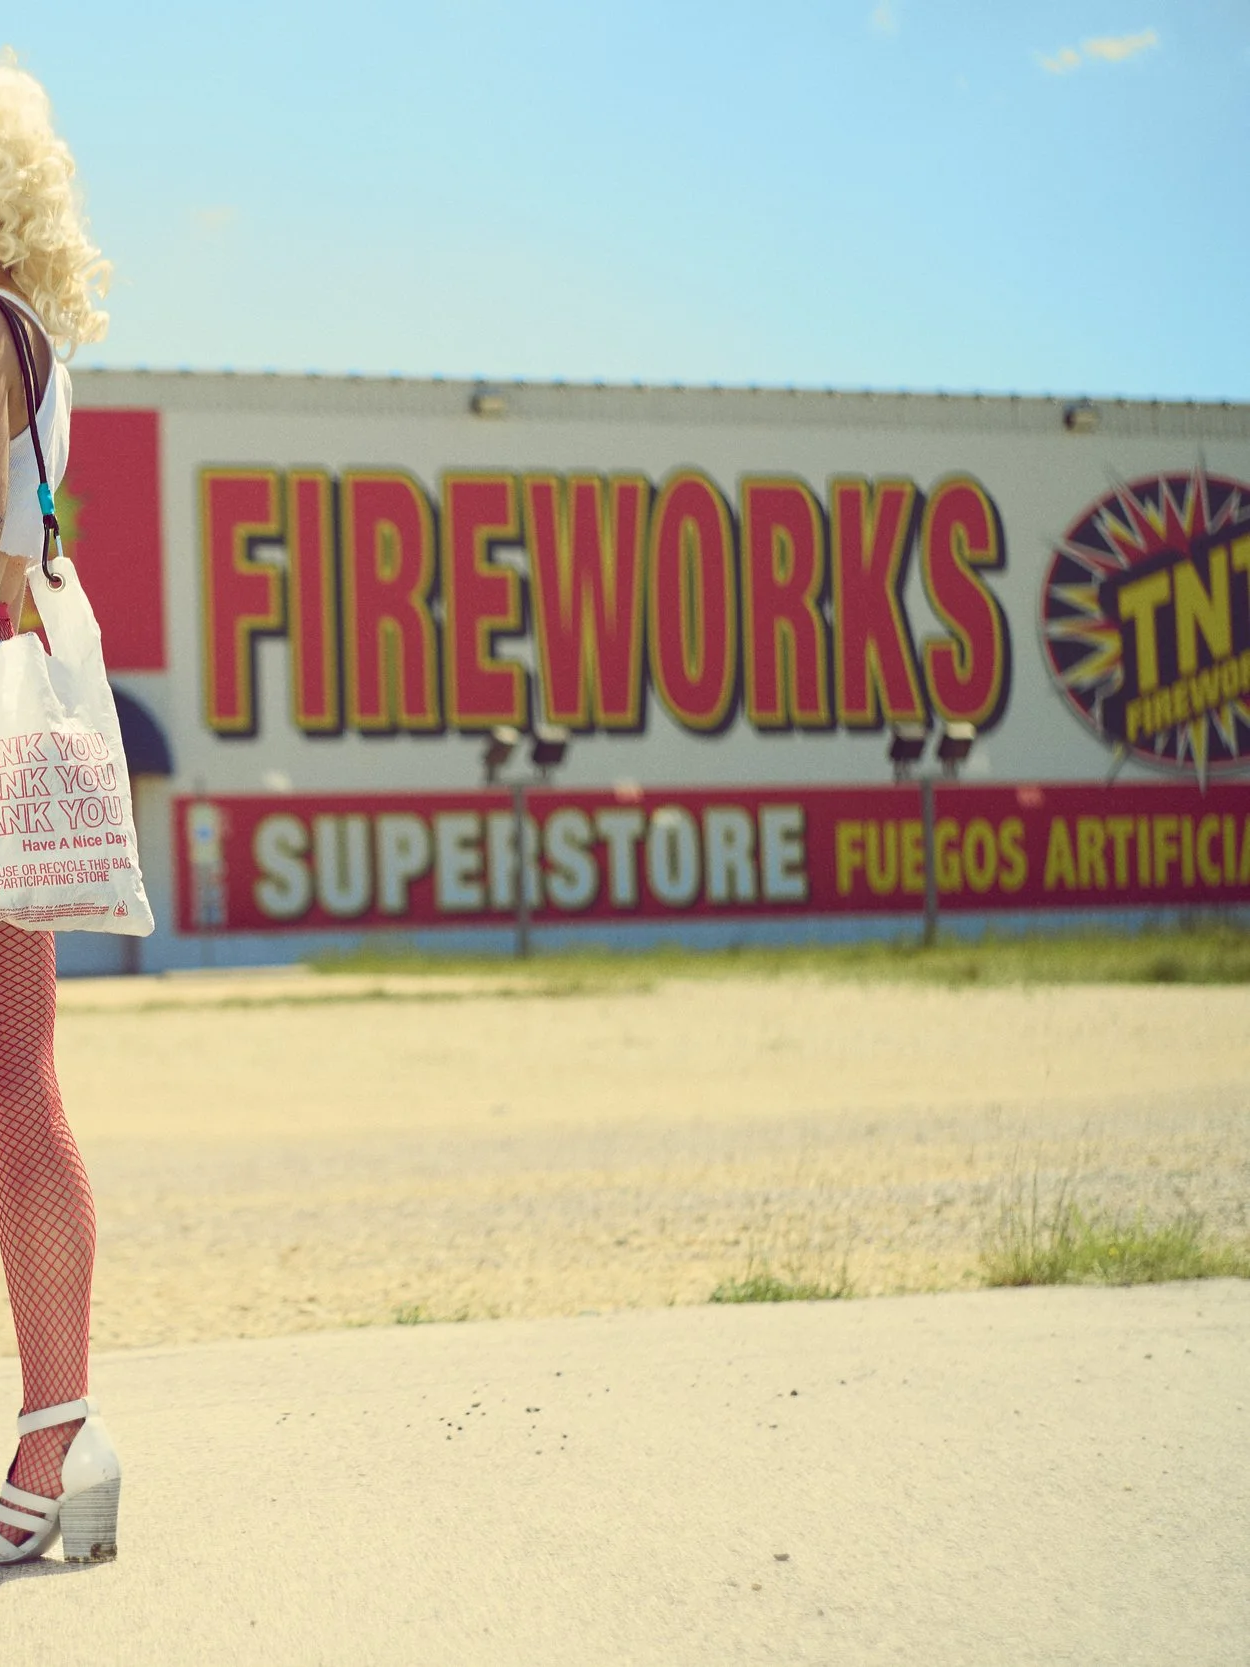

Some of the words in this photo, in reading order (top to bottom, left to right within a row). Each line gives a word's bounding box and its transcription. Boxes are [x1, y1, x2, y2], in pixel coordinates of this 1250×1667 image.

[199, 466, 1010, 738] FIREWORKS
[51, 732, 109, 761] YOU
[55, 763, 116, 794] YOU
[59, 796, 123, 829] YOU
[22, 839, 56, 852] Have
[59, 837, 70, 849] A
[73, 834, 103, 849] Nice
[105, 831, 127, 847] Day
[835, 816, 1028, 896] FUEGOS
[22, 863, 37, 876] OR
[39, 859, 86, 875] RECYCLE
[87, 857, 111, 871] THIS
[112, 856, 132, 870] BAG
[76, 869, 110, 884] STORE
[253, 804, 809, 918] SUPERSTORE
